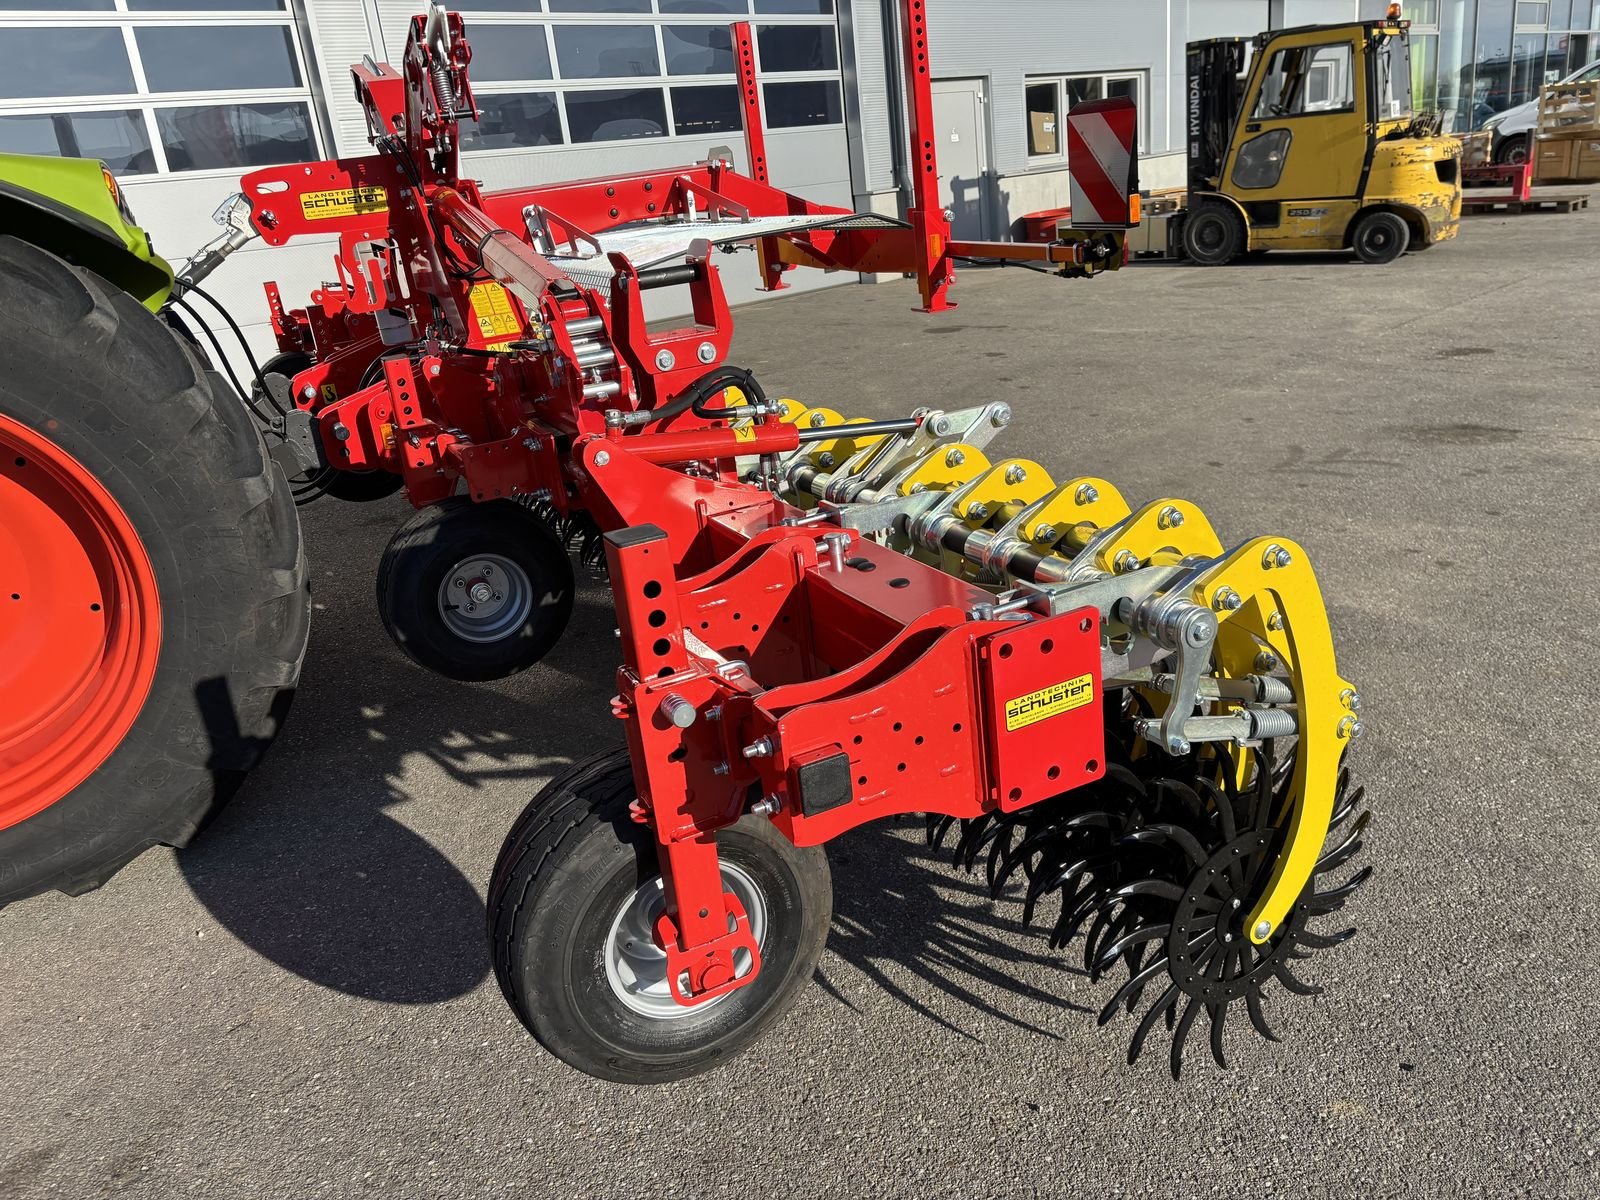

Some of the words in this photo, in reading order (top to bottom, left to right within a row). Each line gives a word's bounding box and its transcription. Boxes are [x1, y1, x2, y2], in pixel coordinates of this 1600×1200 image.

[1190, 75, 1200, 136] HYUNDAI
[308, 188, 377, 199] LANDTECHNIK
[1014, 677, 1085, 706] LANDTECHNIK
